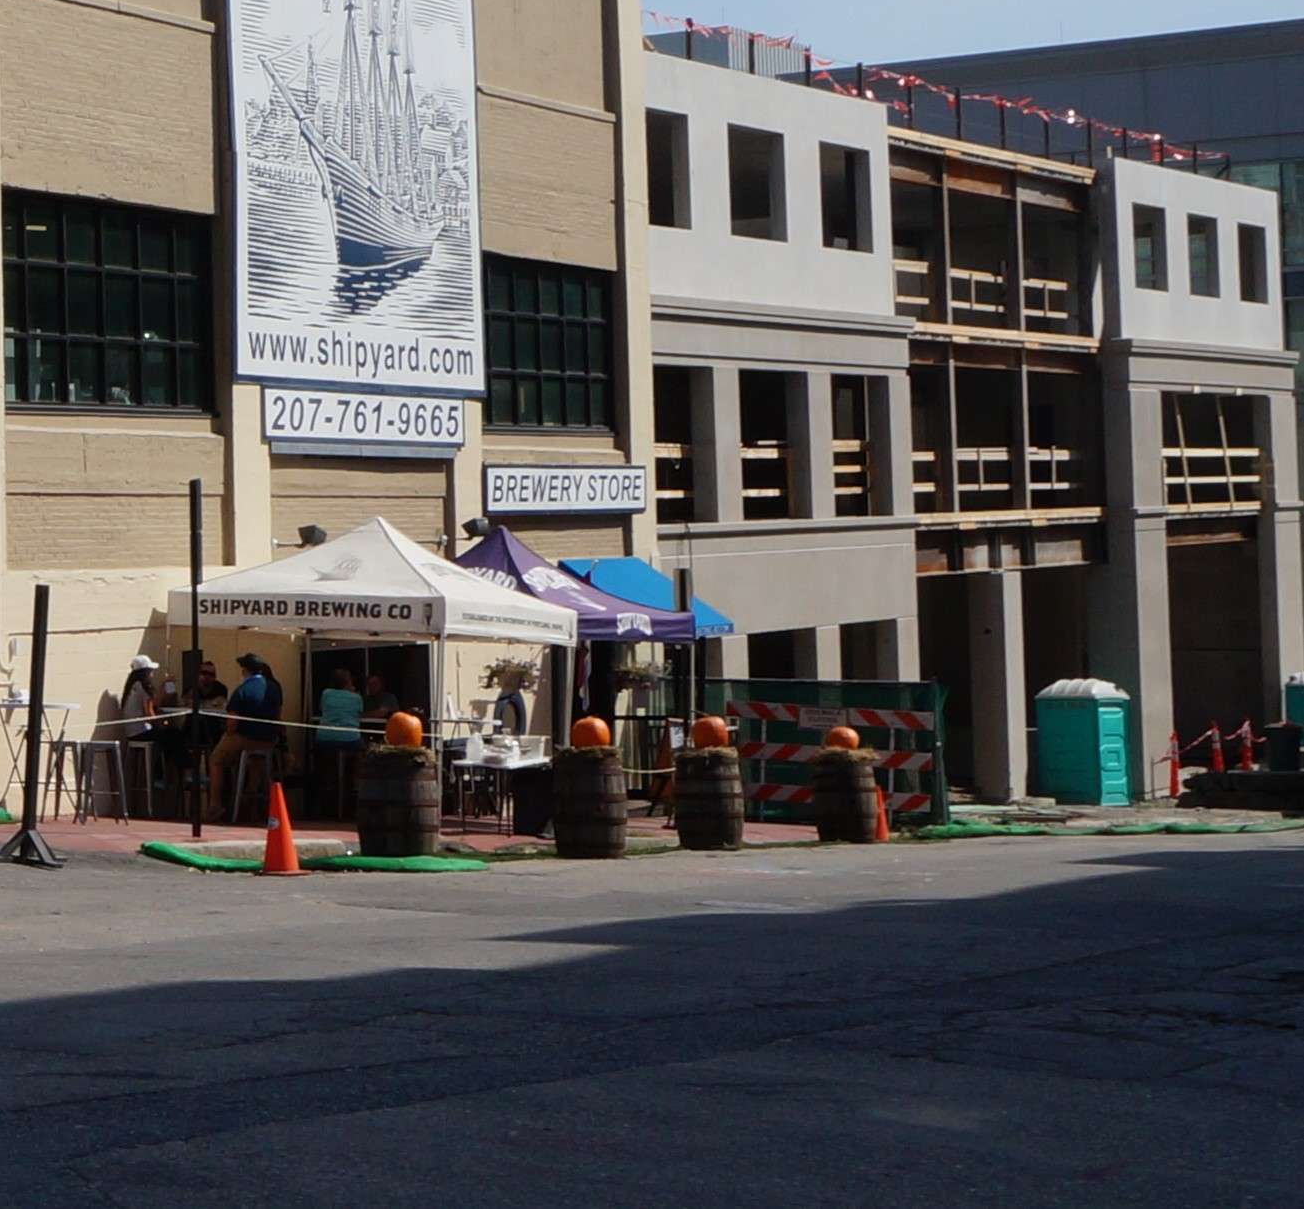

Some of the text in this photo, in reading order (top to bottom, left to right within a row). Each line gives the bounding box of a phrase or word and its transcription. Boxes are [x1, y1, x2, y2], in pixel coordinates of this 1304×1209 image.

[248, 331, 474, 379] www.shipyard.com
[271, 395, 459, 438] 207-761-9665
[492, 474, 641, 503] BREWERY STORE
[199, 598, 412, 620] SHIPYARD BREWING CO
